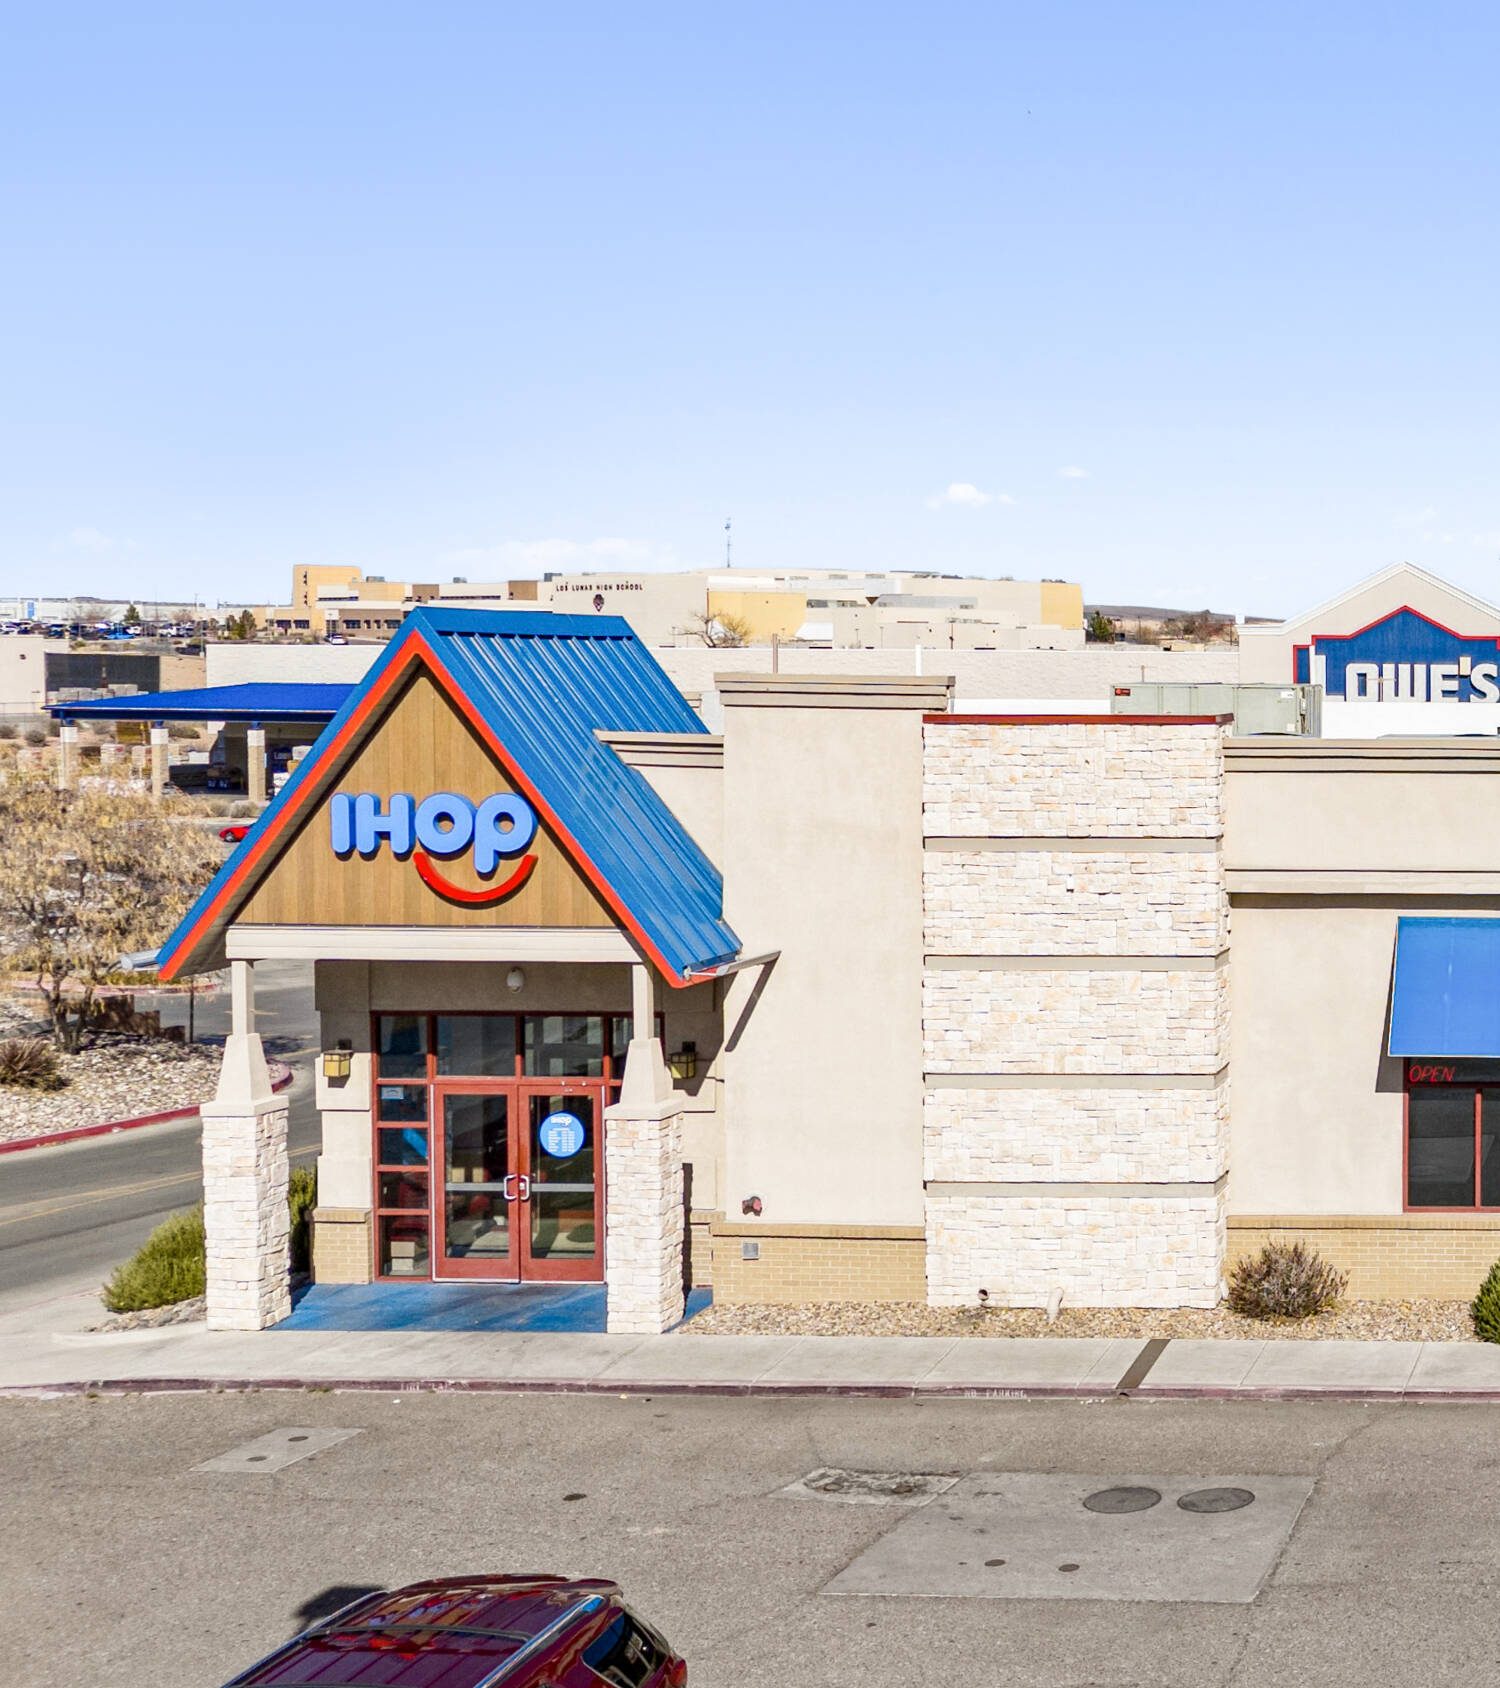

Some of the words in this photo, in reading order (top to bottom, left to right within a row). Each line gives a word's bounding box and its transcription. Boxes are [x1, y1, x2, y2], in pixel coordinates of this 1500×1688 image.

[556, 584, 568, 592] LOS
[572, 584, 593, 592] LUNAS
[616, 583, 643, 591] SCHOOL
[331, 792, 538, 874] IHOP
[1409, 1064, 1456, 1082] OPEN
